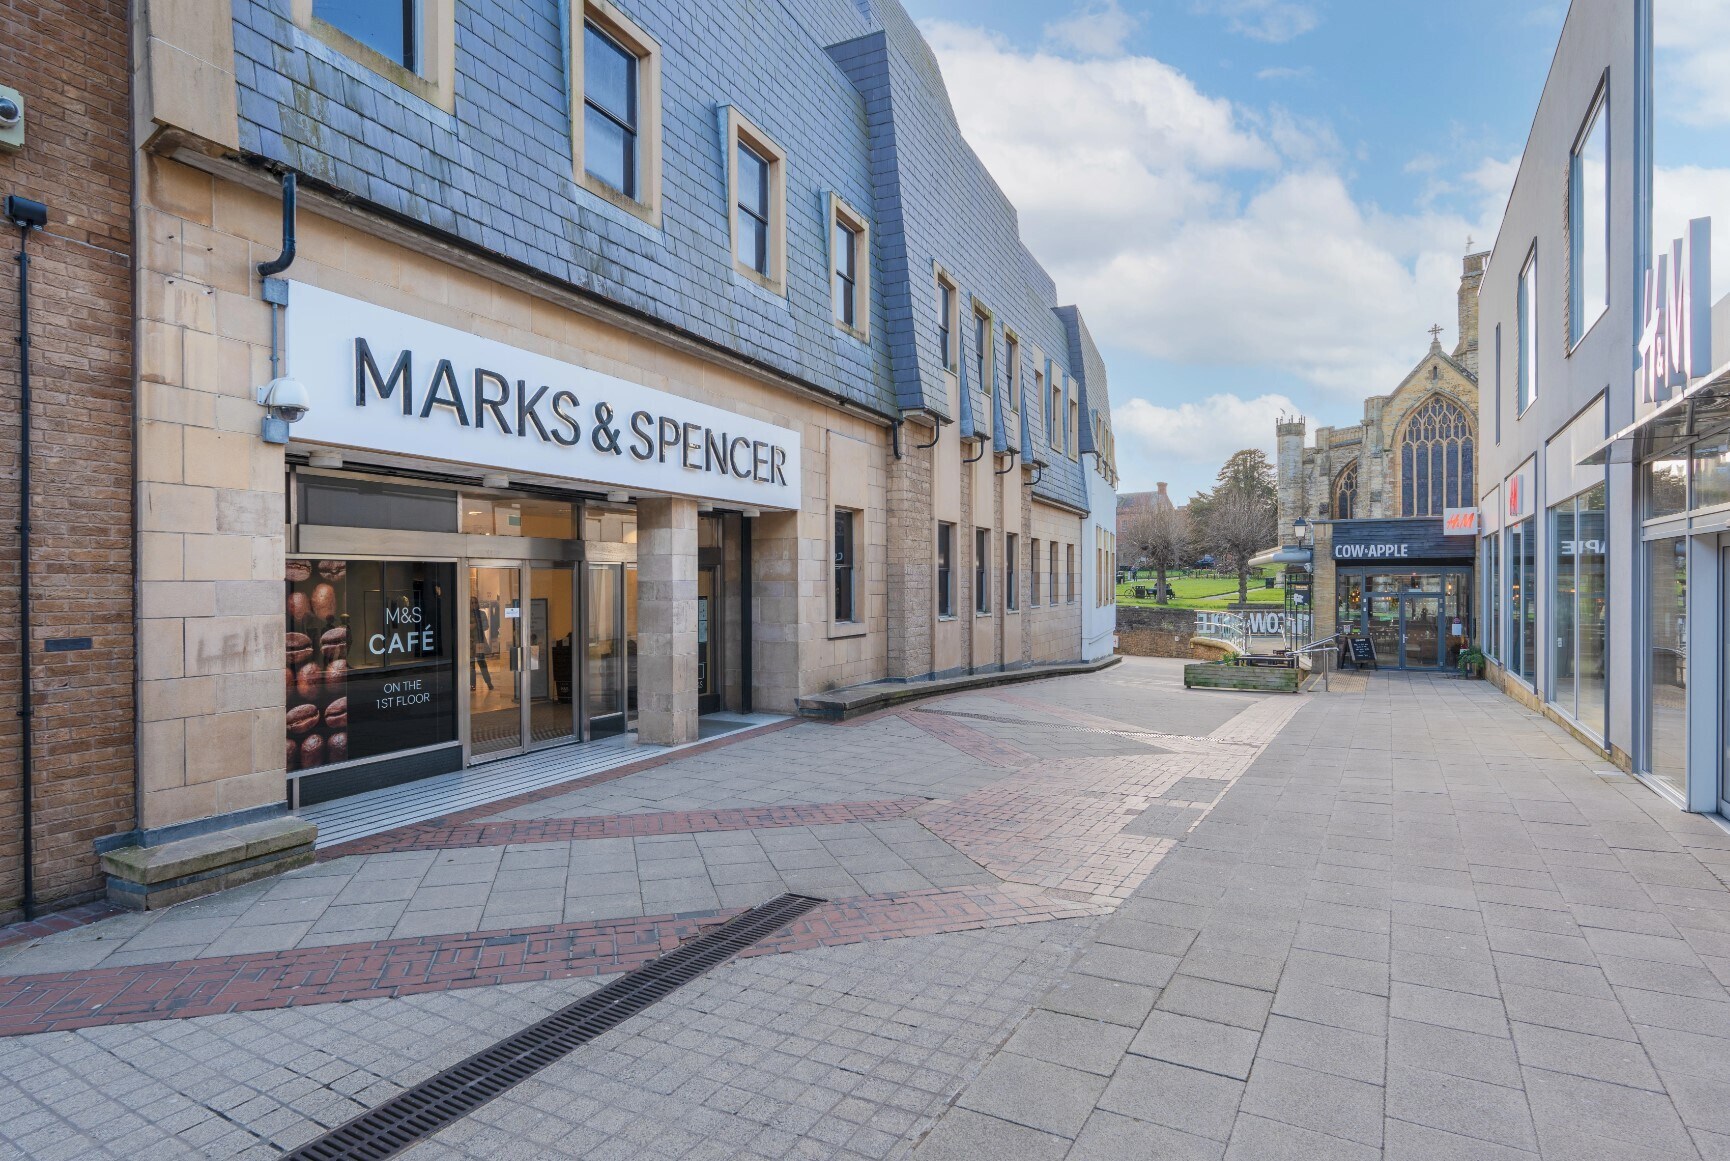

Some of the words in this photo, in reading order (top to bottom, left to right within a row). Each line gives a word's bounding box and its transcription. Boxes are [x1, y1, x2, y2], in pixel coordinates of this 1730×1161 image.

[1638, 216, 1711, 403] H&M
[355, 337, 581, 445] MARKS
[591, 401, 622, 455] &
[629, 410, 788, 486] SPENCER
[386, 606, 422, 625] M&S
[368, 624, 434, 655] CAFÉ
[383, 682, 401, 693] ON
[402, 679, 422, 691] THE
[376, 697, 394, 709] 1ST
[396, 692, 430, 707] FLOOR
